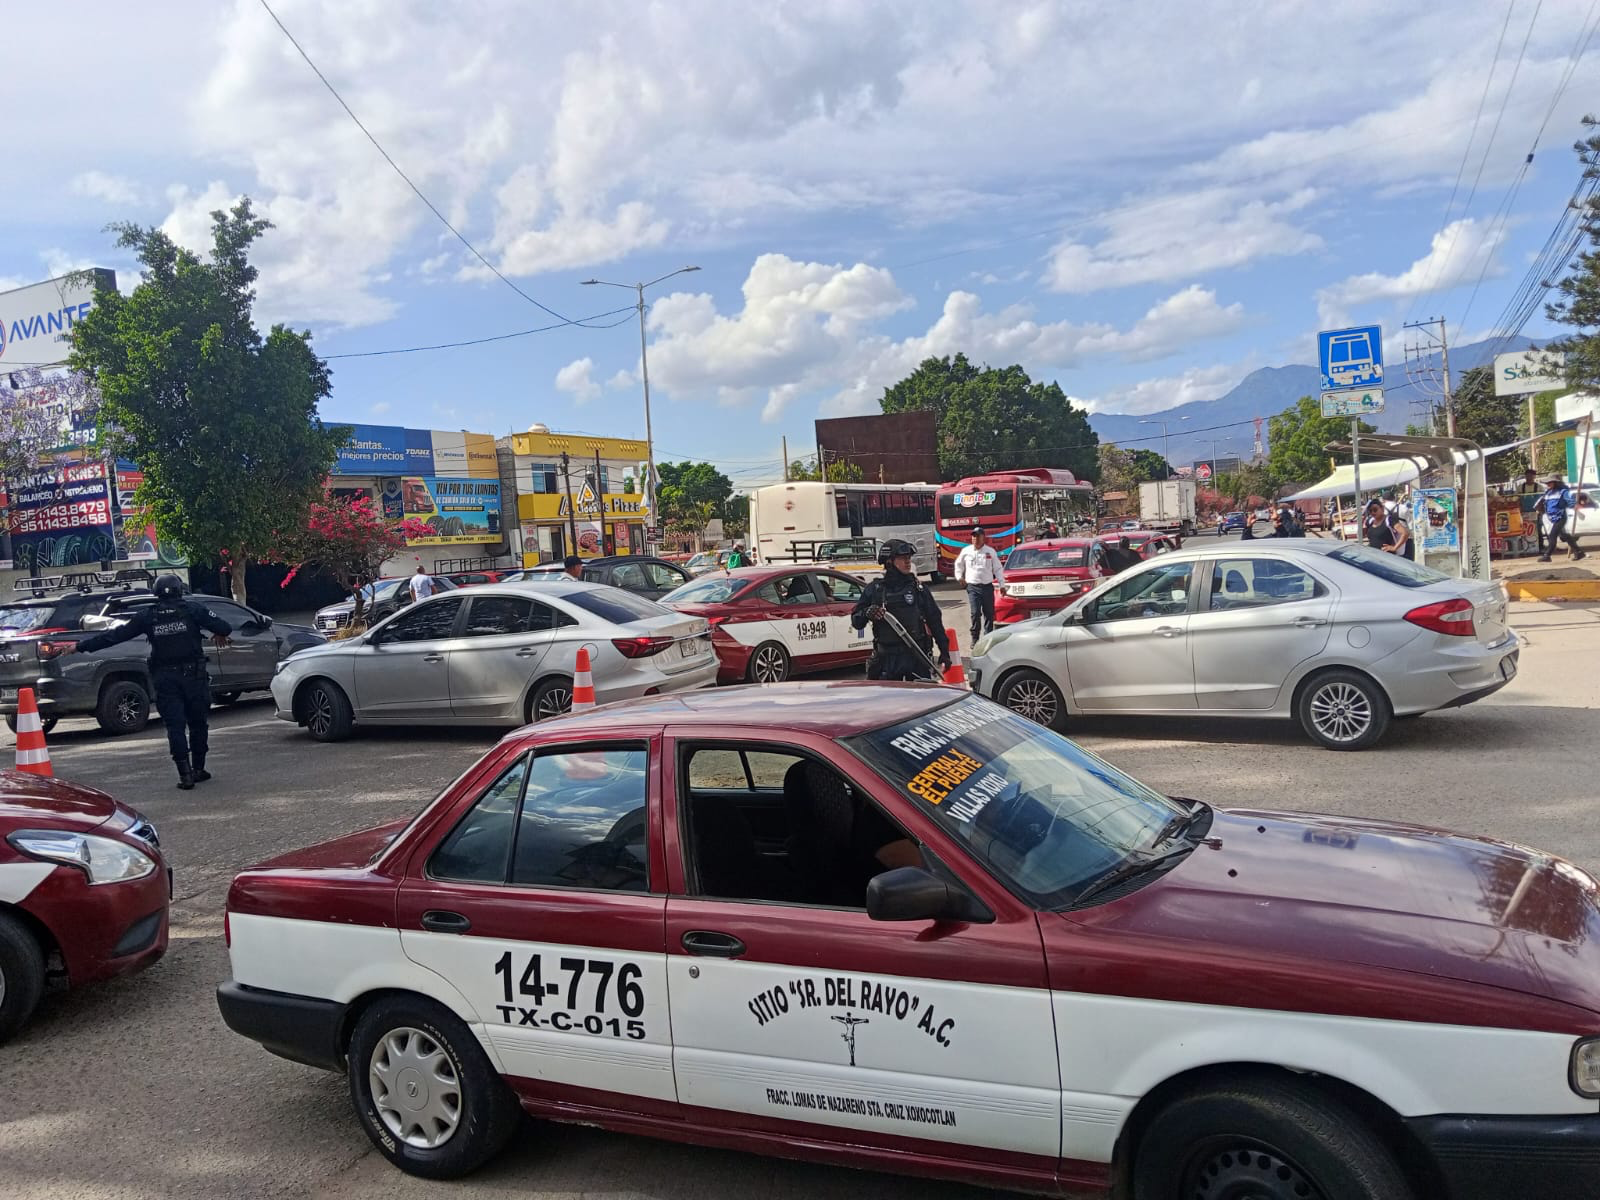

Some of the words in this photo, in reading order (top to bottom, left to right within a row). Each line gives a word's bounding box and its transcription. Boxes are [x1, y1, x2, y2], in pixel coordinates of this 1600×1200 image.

[67, 465, 102, 481] RINES
[341, 451, 372, 461] mejores
[372, 450, 405, 462] precios
[20, 513, 108, 532] 951.143.8458
[612, 497, 642, 513] Pizza
[796, 620, 827, 637] 19-948
[0, 653, 20, 663] AM
[890, 726, 951, 760] FRACC.
[907, 754, 960, 795] CENTRAL
[921, 787, 949, 807] EL
[936, 756, 983, 791] PUENTE
[945, 786, 991, 824] VILLAS
[494, 951, 645, 1018] 14-776
[495, 1004, 646, 1040] TX-C-015
[748, 985, 789, 1026] SITIO
[824, 977, 856, 1007] DEL
[917, 1004, 955, 1047] A.C.
[766, 1087, 793, 1107] FRACC.
[791, 1091, 817, 1109] LOMAS
[816, 1094, 828, 1111] DE
[827, 1095, 867, 1116] NAZARENO
[866, 1100, 884, 1118] STA.
[884, 1102, 906, 1121] CRUZ
[905, 1105, 957, 1127] XOXOCOTLAN
